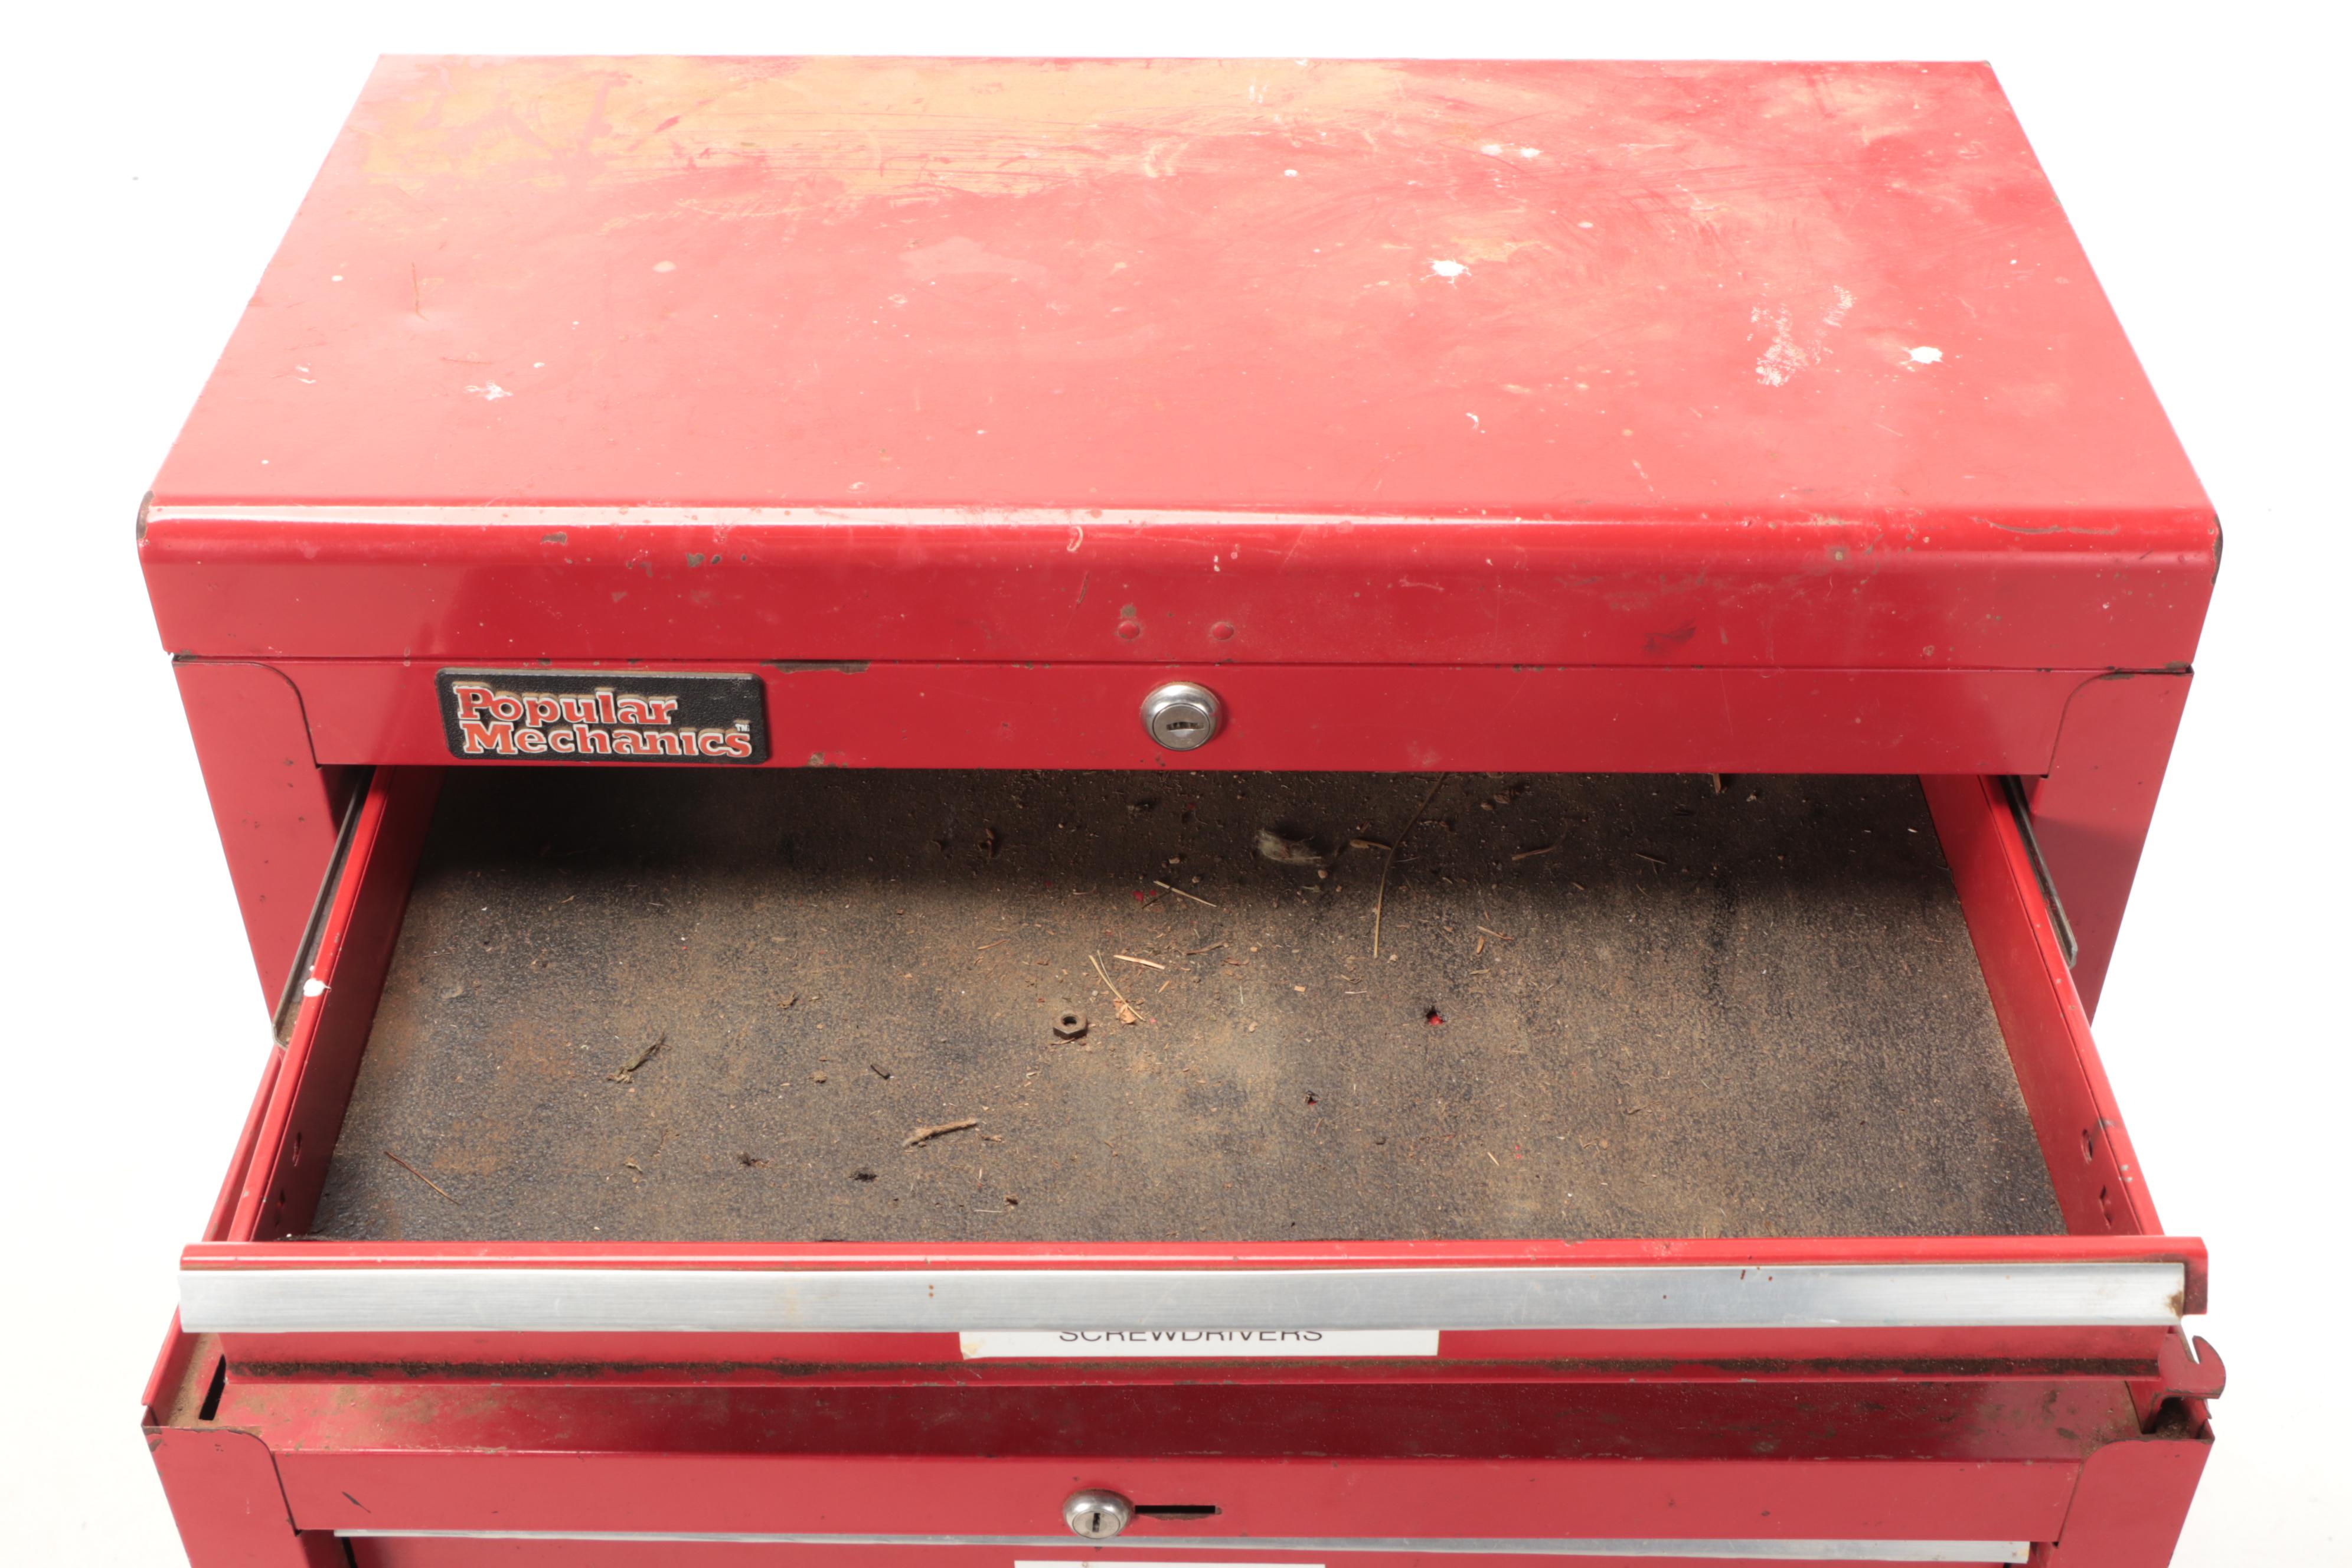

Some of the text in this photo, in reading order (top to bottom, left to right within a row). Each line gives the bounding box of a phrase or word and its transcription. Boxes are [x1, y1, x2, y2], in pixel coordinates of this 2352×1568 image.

[453, 684, 678, 727] Popular
[459, 720, 752, 757] Mechanics
[1059, 1331, 1322, 1341] SCREWDRIVERS
